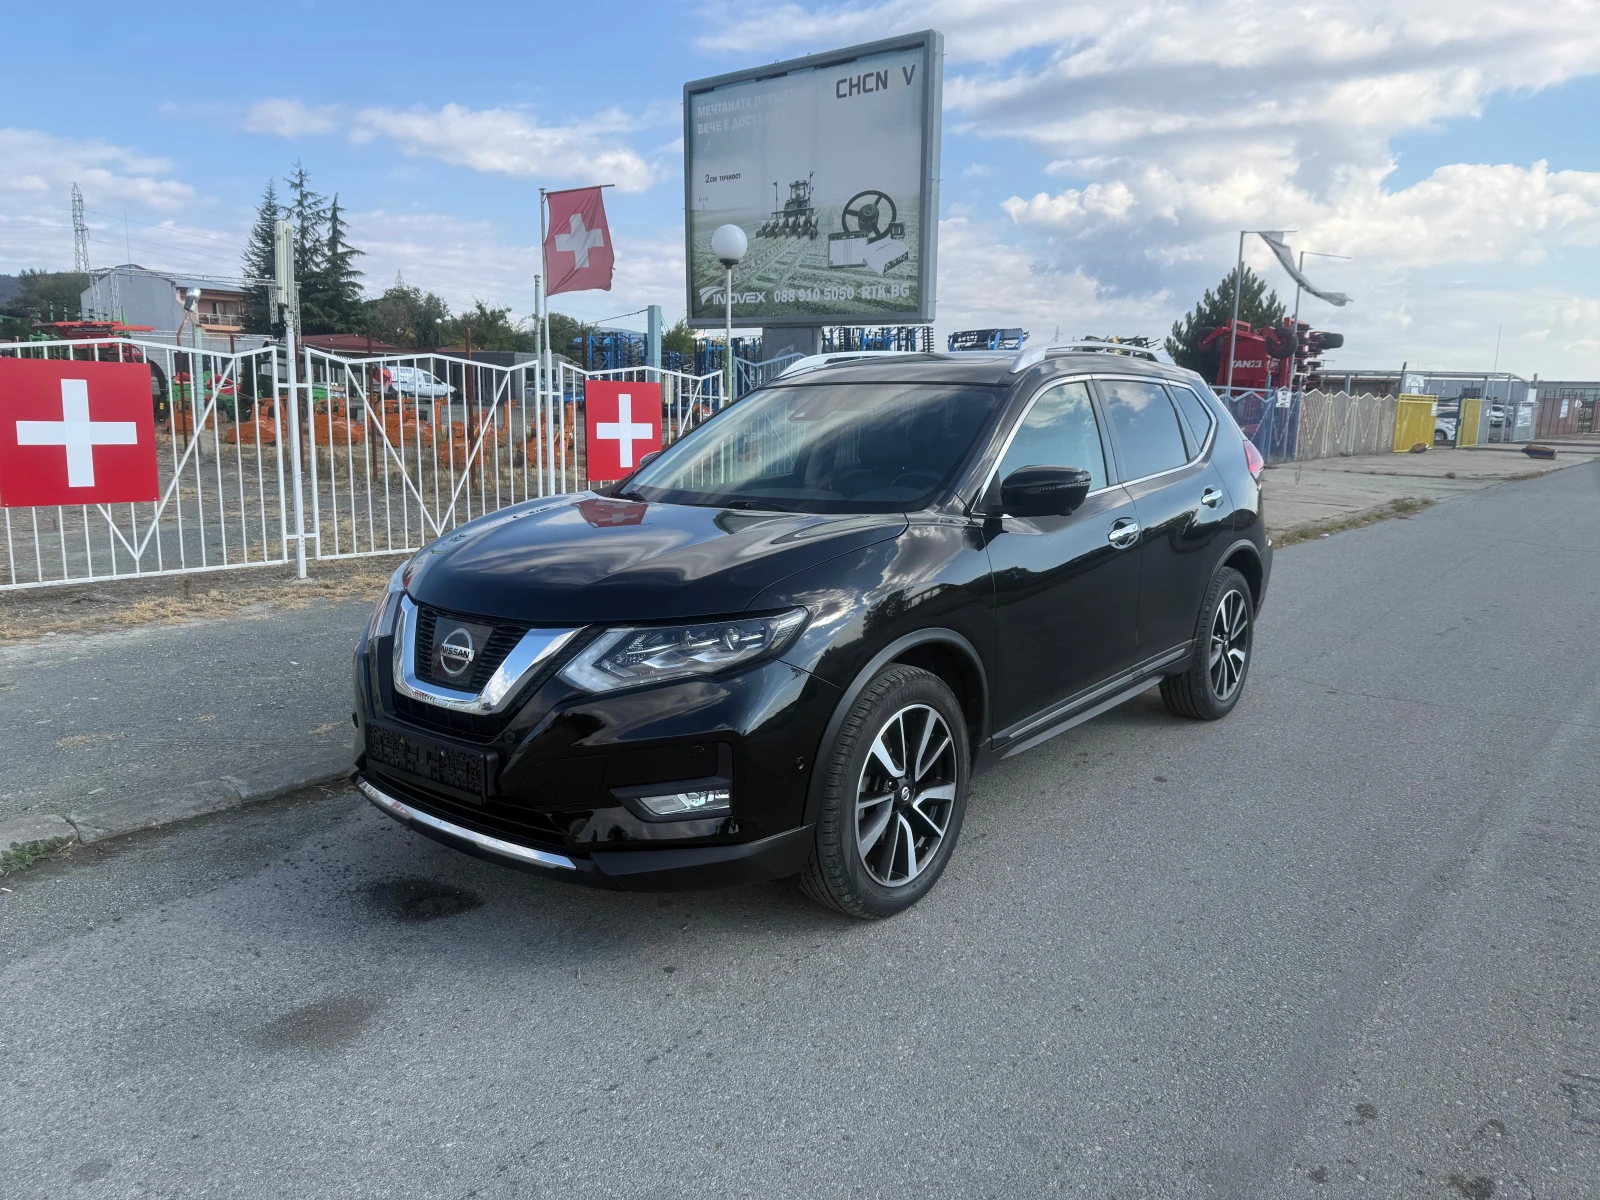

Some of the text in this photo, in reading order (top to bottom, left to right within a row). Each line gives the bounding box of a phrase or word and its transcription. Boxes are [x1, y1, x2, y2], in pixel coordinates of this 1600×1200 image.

[697, 98, 752, 117] МЕЧТАНАТА
[698, 120, 722, 135] ВЕЧЕ
[713, 283, 910, 305] INOVEX 088 910 5050 RTK.BG
[442, 646, 470, 659] NISSAN
